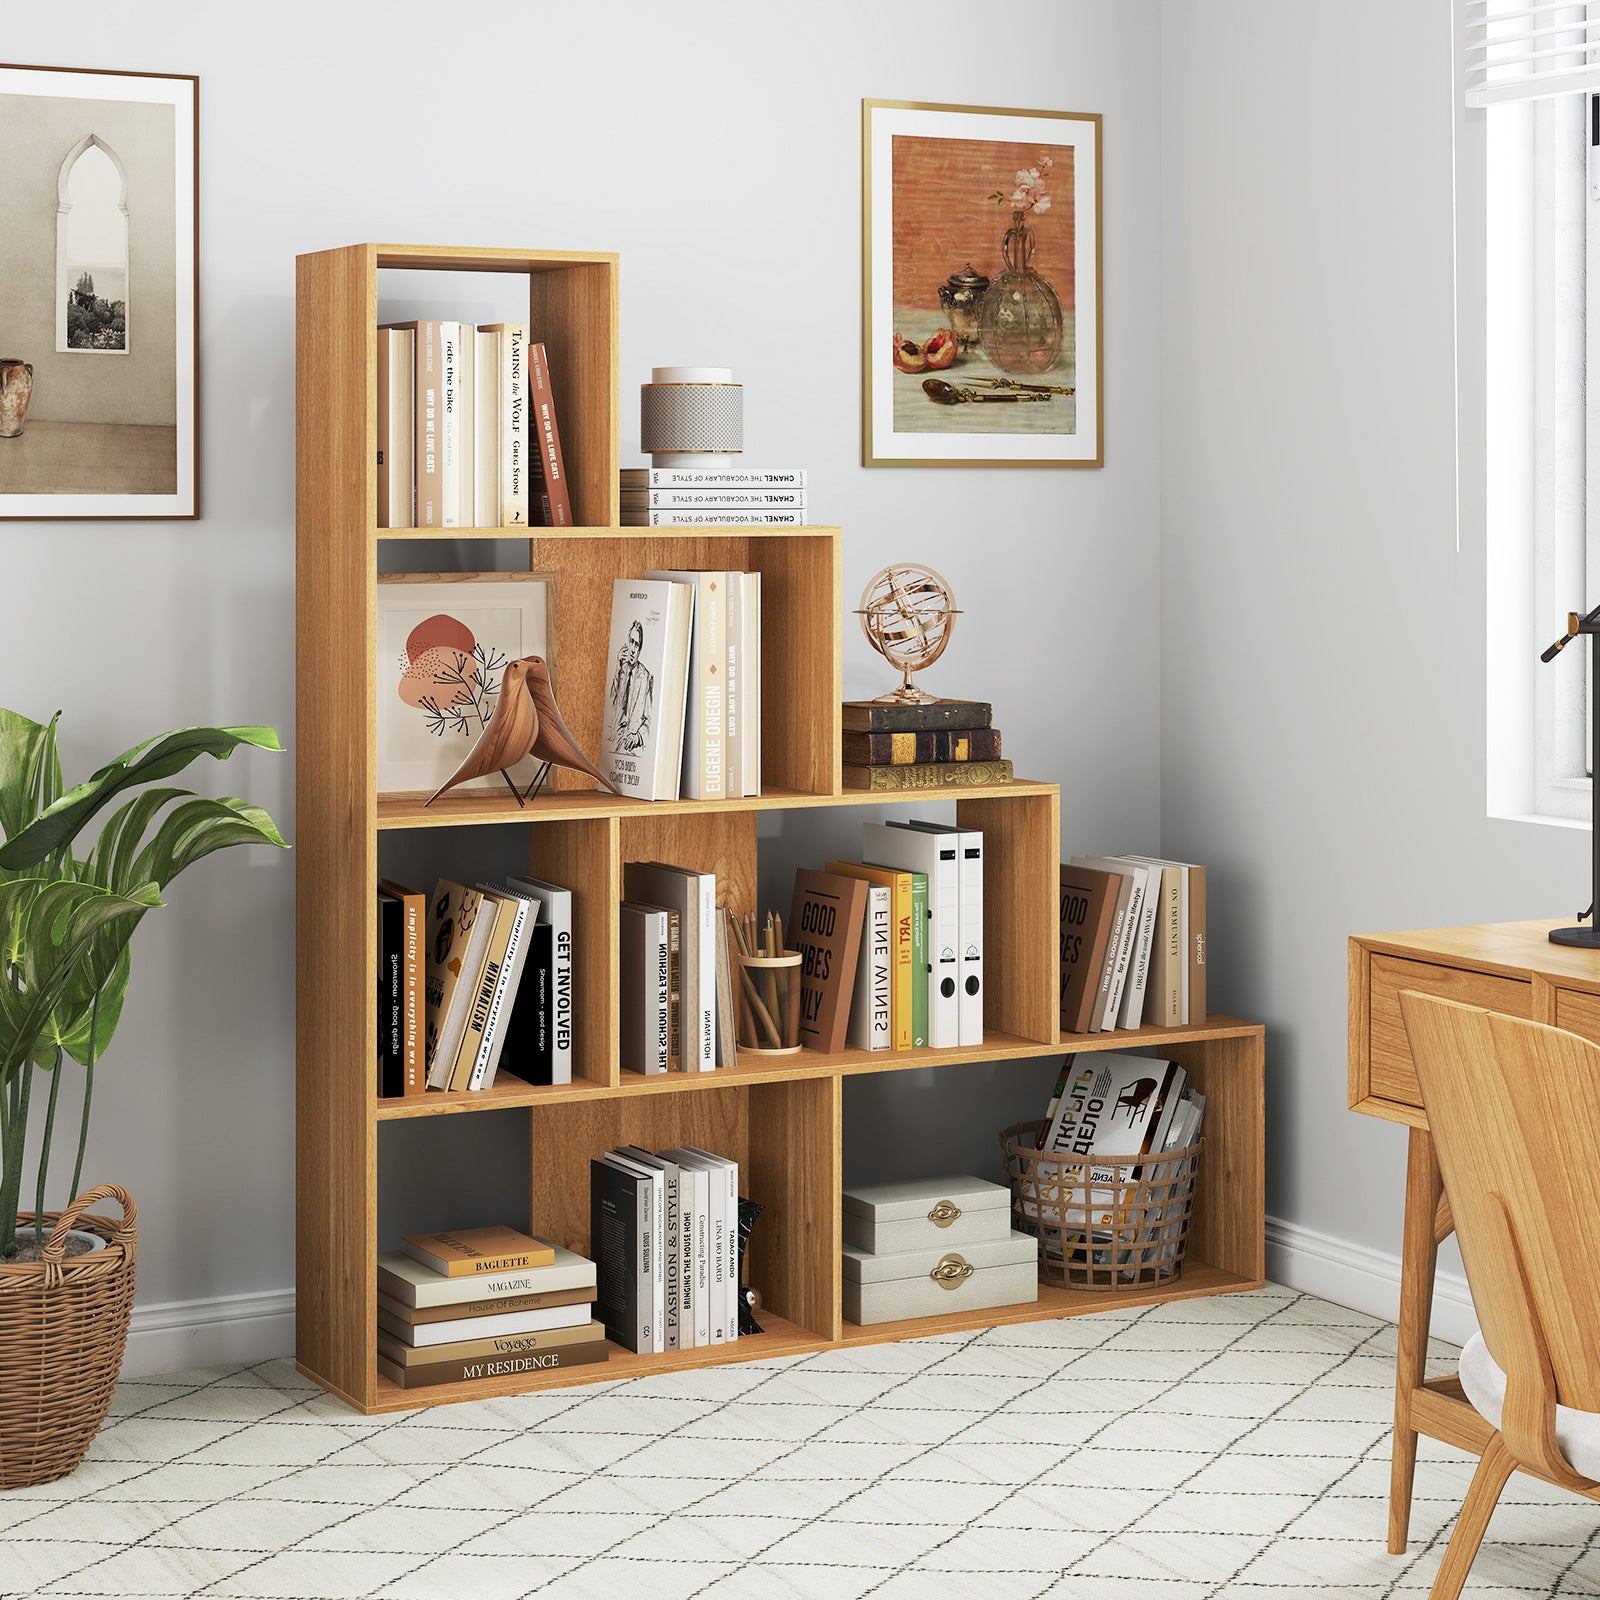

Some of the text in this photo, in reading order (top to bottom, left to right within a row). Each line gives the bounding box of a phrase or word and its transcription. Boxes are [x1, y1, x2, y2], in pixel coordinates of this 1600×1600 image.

[446, 341, 454, 364] ride
[446, 367, 454, 386] the
[512, 329, 522, 433] TAMING the WOLF
[446, 389, 454, 414] bike
[426, 389, 435, 474] WHY DO WE LOVE CATS
[541, 403, 560, 480] WHY DO WE LOVE CATS
[512, 440, 521, 496] GREG STONE
[672, 474, 693, 482] STYLE
[694, 474, 704, 482] OF
[705, 474, 749, 482] VOCABULARY
[751, 474, 763, 482] THE
[764, 474, 795, 482] CHANEL
[672, 495, 693, 503] STYLE
[694, 495, 704, 503] OF
[705, 495, 749, 503] VOCABULARY
[751, 495, 763, 503] THE
[764, 495, 795, 503] CHANEL
[672, 515, 693, 523] STYLE
[694, 515, 704, 523] OF
[705, 515, 749, 523] VOCABULARY
[751, 515, 763, 523] THE
[764, 515, 795, 523] CHANEL
[728, 645, 736, 737] WHY DO WE LOVE CATS
[705, 685, 720, 793] EUGENE ONEGIN
[1171, 888, 1178, 901] ON
[1060, 894, 1088, 925] OOD
[801, 900, 836, 937] GOOD
[1115, 910, 1125, 934] GUIDE
[407, 906, 417, 961] simplicity
[507, 911, 524, 960] simplicity
[1117, 963, 1125, 973] for
[1122, 915, 1136, 956] sustainable
[1130, 887, 1142, 914] lifestyle
[1110, 935, 1119, 958] GOOD
[1136, 961, 1145, 990] DREAM
[1144, 907, 1154, 936] AWAKE
[409, 963, 417, 973] is
[504, 964, 511, 972] is
[1106, 966, 1113, 975] IS
[409, 976, 417, 987] in
[501, 976, 507, 986] in
[1102, 975, 1111, 992] THIS
[471, 961, 500, 1032] MINIMALISM
[557, 931, 571, 1051] GET INVOLVED
[800, 986, 823, 1022] NLY
[407, 990, 417, 1047] everything
[485, 989, 503, 1043] everything
[538, 1010, 546, 1028] good
[538, 1028, 546, 1052] design
[409, 1050, 416, 1065] we
[481, 1046, 488, 1059] we
[1052, 1069, 1094, 1153] ТКРЫТЬ
[1072, 1098, 1104, 1156] ДЕЛО
[1090, 1172, 1126, 1184] ДИЗАН
[698, 1214, 706, 1258] Constructing
[667, 1178, 678, 1328] FASHION & STYLE
[716, 1242, 722, 1255] BO
[475, 1256, 529, 1271] BAGUETTE
[683, 1211, 691, 1310] BRINGING THE HOUSE HOME
[487, 1279, 532, 1293] MAGAZINE
[468, 1296, 541, 1313] House Of Boheme
[493, 1337, 537, 1353] Voyage
[463, 1354, 560, 1379] MY RESIDENCE
